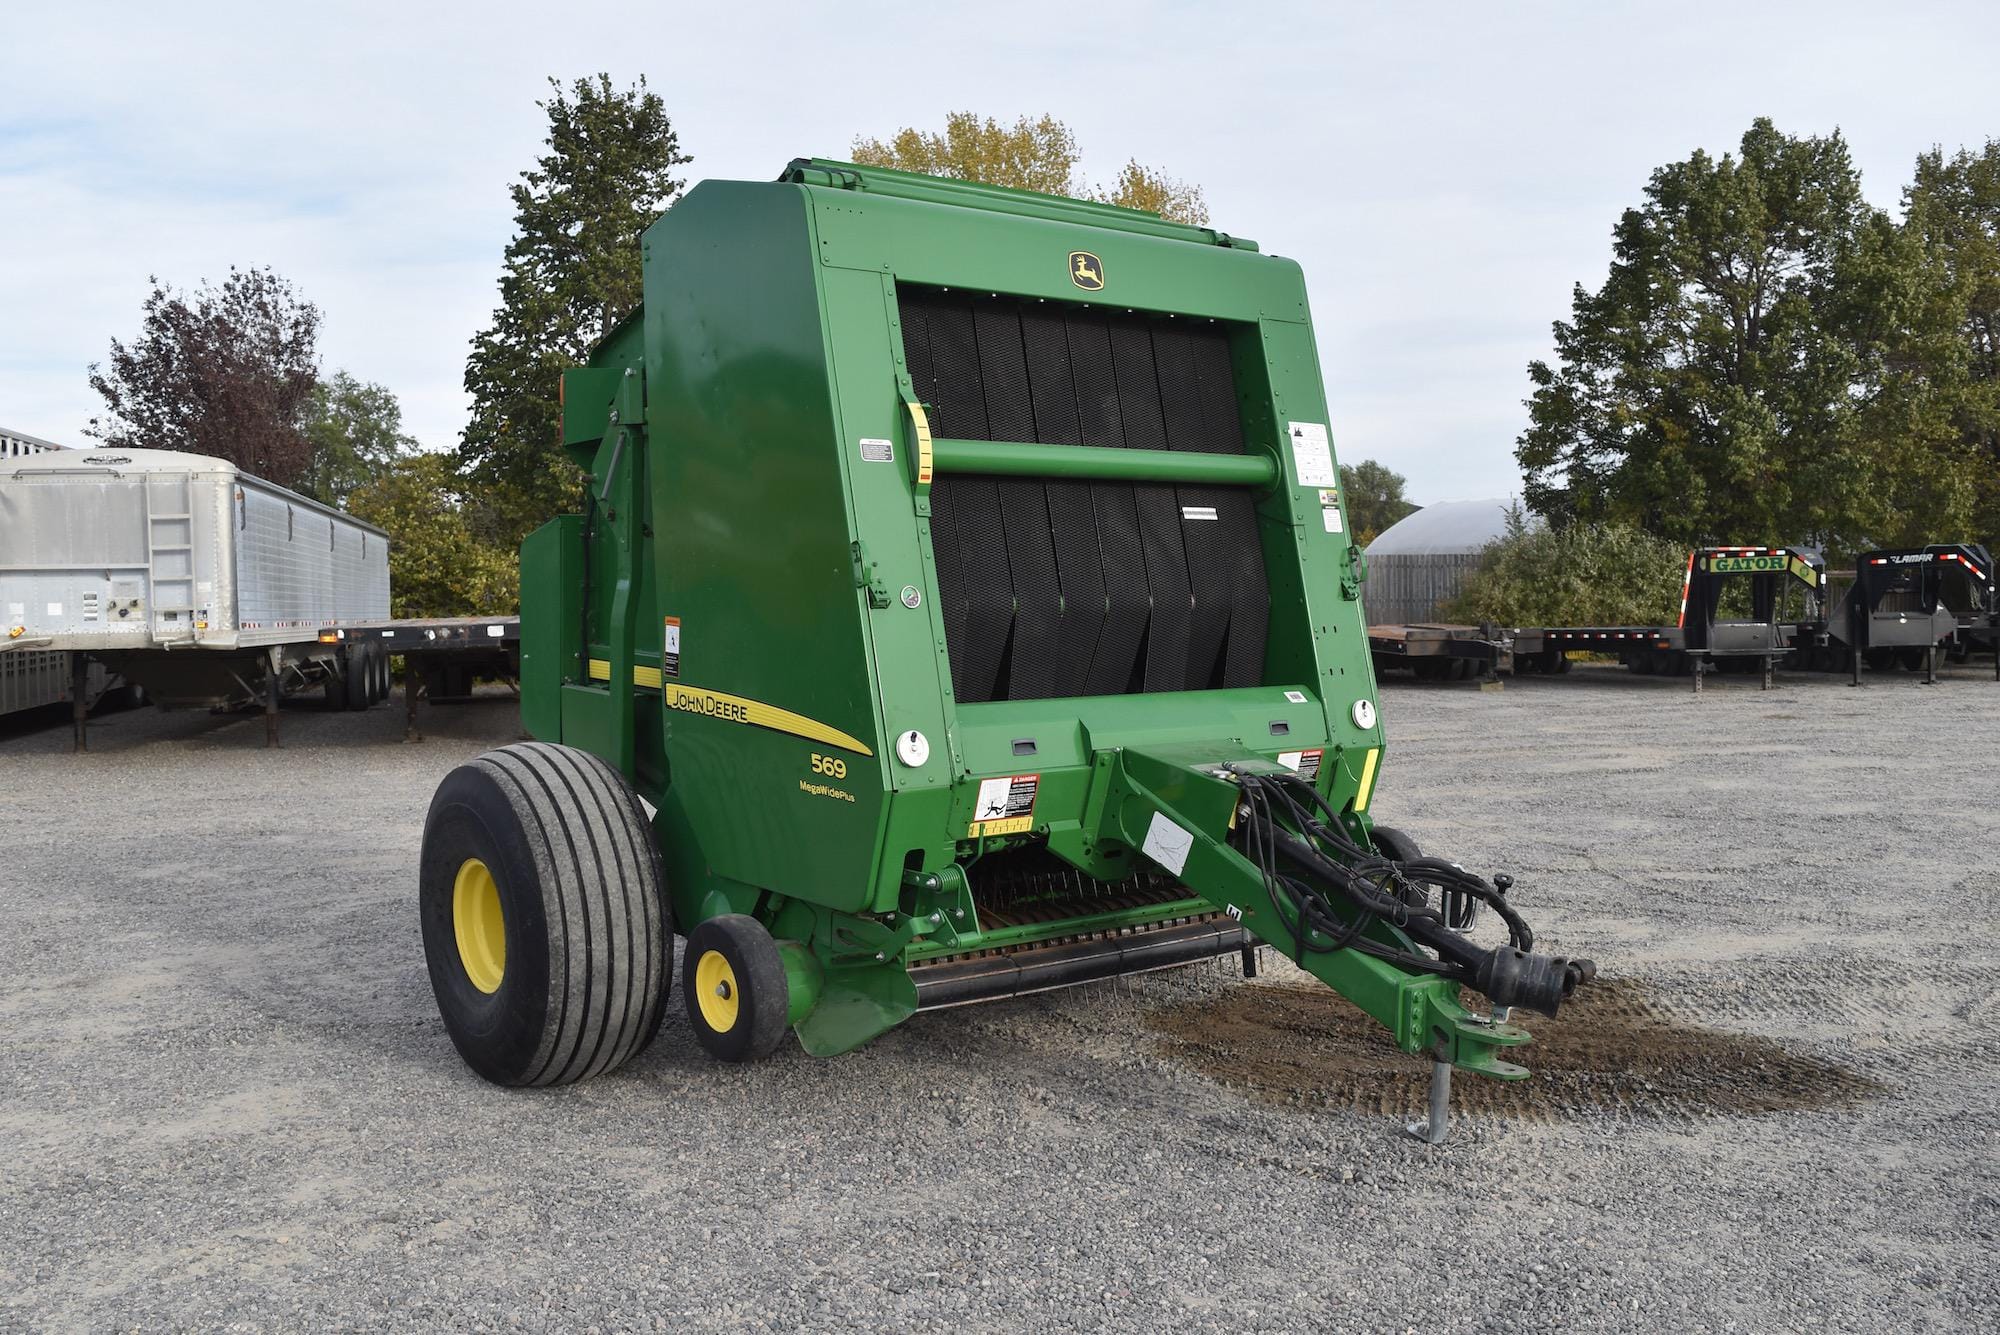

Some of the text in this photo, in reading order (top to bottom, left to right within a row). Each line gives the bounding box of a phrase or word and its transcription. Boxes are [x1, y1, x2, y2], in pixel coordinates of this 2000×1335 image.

[1716, 557, 1785, 571] GATOR
[1895, 553, 1934, 564] LAMAR
[673, 690, 748, 720] JOHN DEERE
[811, 752, 847, 779] 569
[799, 779, 856, 802] MegaWidePlus
